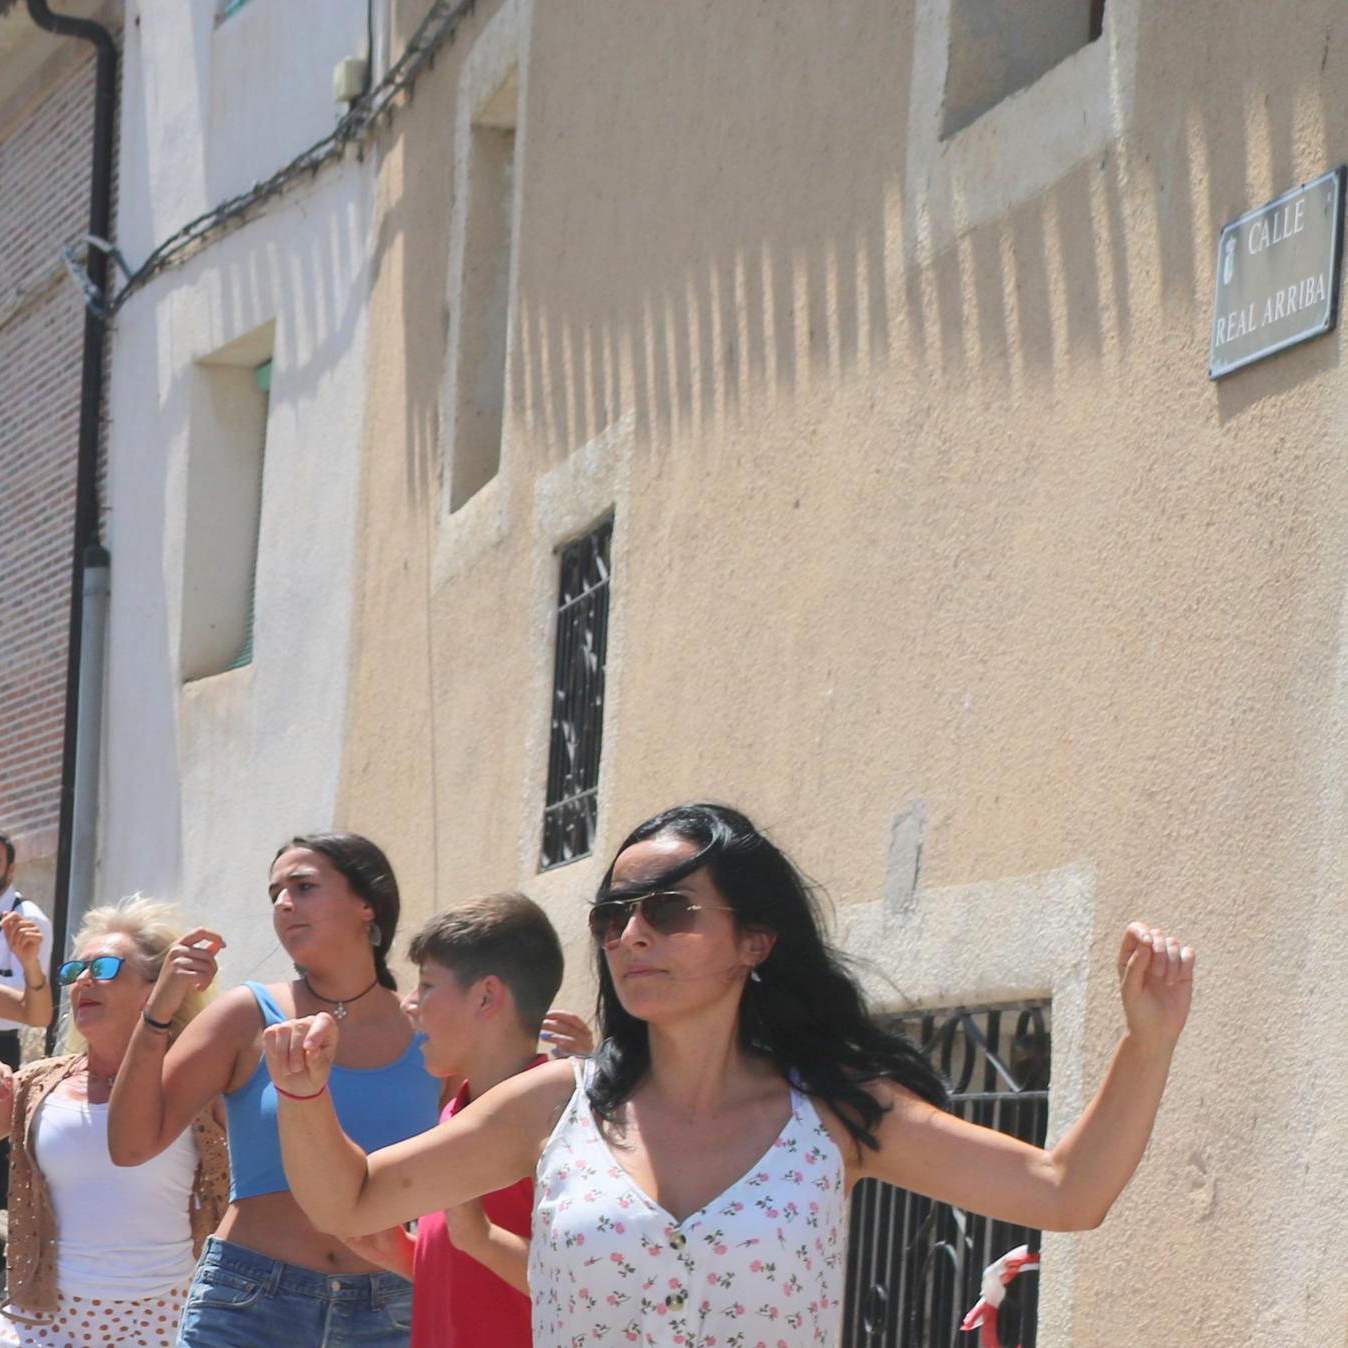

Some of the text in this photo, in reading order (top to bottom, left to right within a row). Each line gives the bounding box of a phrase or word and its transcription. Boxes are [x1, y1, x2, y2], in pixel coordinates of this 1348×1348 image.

[1248, 199, 1305, 254] CALLE
[1215, 273, 1325, 348] REAL ARRIBA
